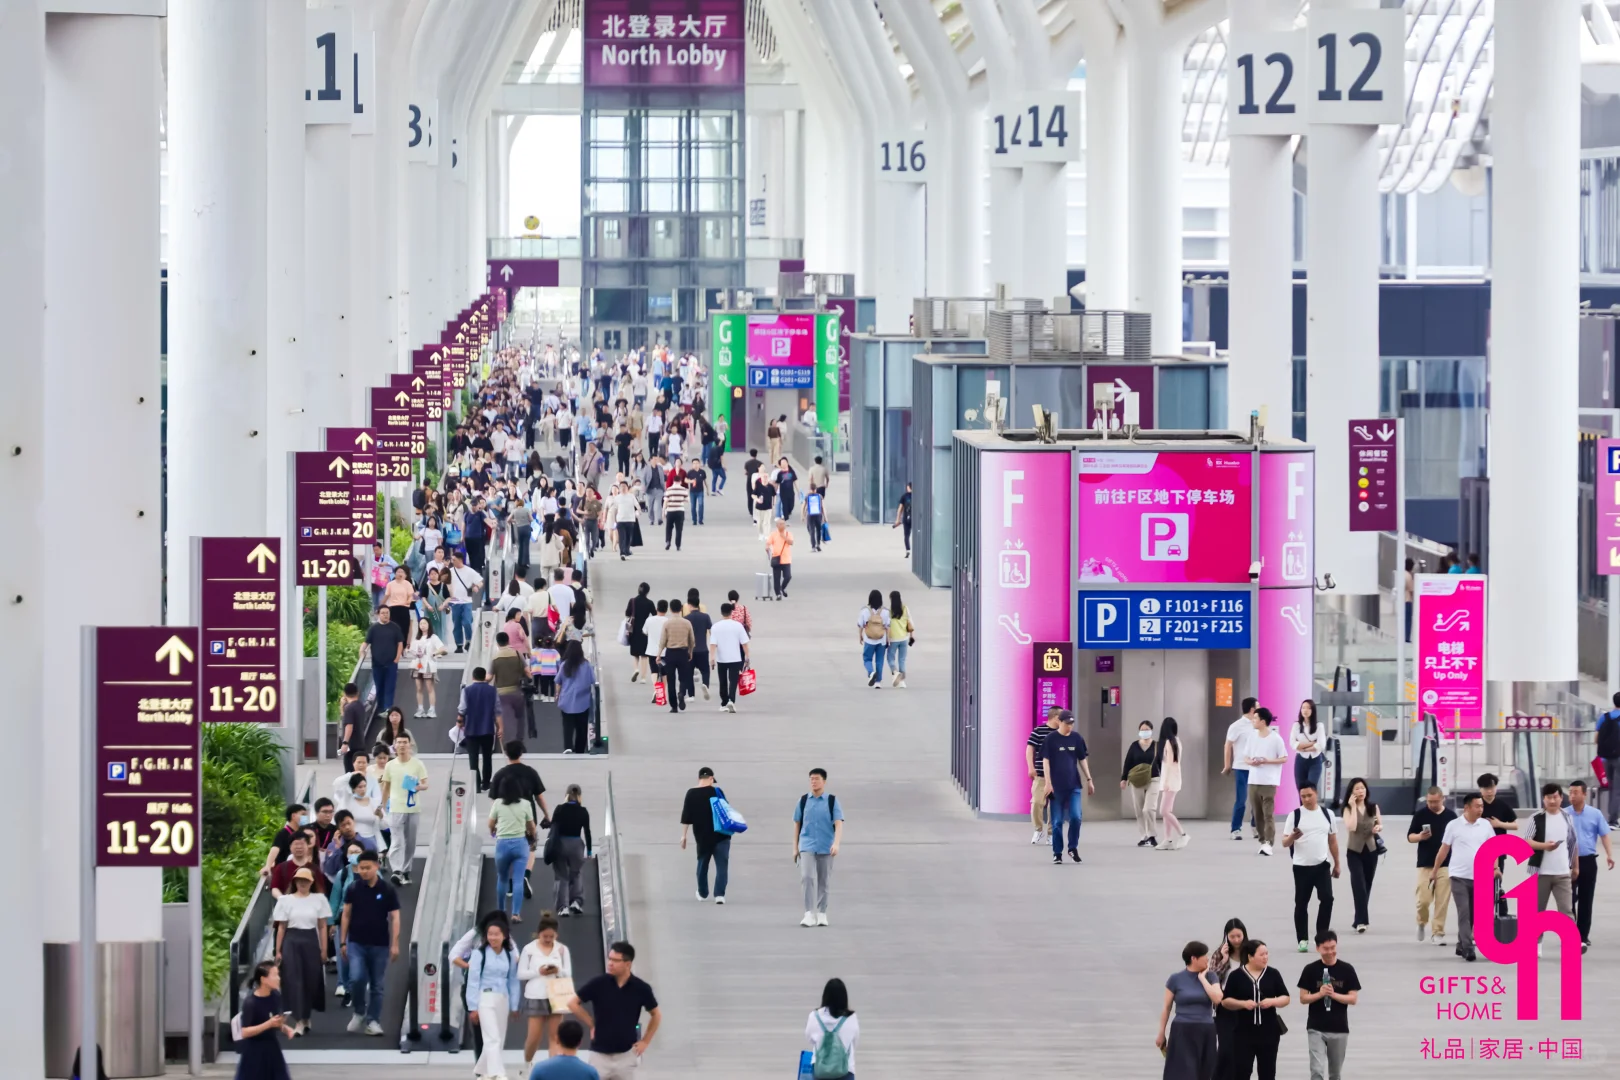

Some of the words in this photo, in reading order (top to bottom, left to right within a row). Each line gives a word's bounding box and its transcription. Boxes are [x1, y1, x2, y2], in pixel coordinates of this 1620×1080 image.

[602, 15, 727, 38] 北登录大厅
[305, 32, 341, 100] 1
[602, 44, 660, 66] North
[667, 43, 727, 71] Lobby
[1317, 32, 1383, 101] 12
[1237, 52, 1296, 114] 12
[408, 104, 422, 148] 3
[1028, 105, 1068, 147] 14
[719, 320, 732, 344] G
[826, 318, 836, 342] G
[426, 407, 442, 418] 20
[411, 441, 424, 454] 20
[1004, 470, 1024, 527] F
[1094, 488, 1235, 505] 前往F区地下停车场
[1288, 462, 1305, 520] F
[352, 522, 374, 538] 20
[1148, 518, 1176, 556] P
[302, 559, 350, 578] 11-20
[1097, 603, 1117, 637] P
[1438, 641, 1465, 655] 电梯
[1425, 656, 1477, 670] 只上不下
[1433, 671, 1446, 681] Up
[1448, 671, 1468, 681] Only
[210, 686, 276, 712] 11-20
[137, 711, 164, 722] North
[165, 711, 193, 725] Lobby
[107, 821, 194, 854] 11-20
